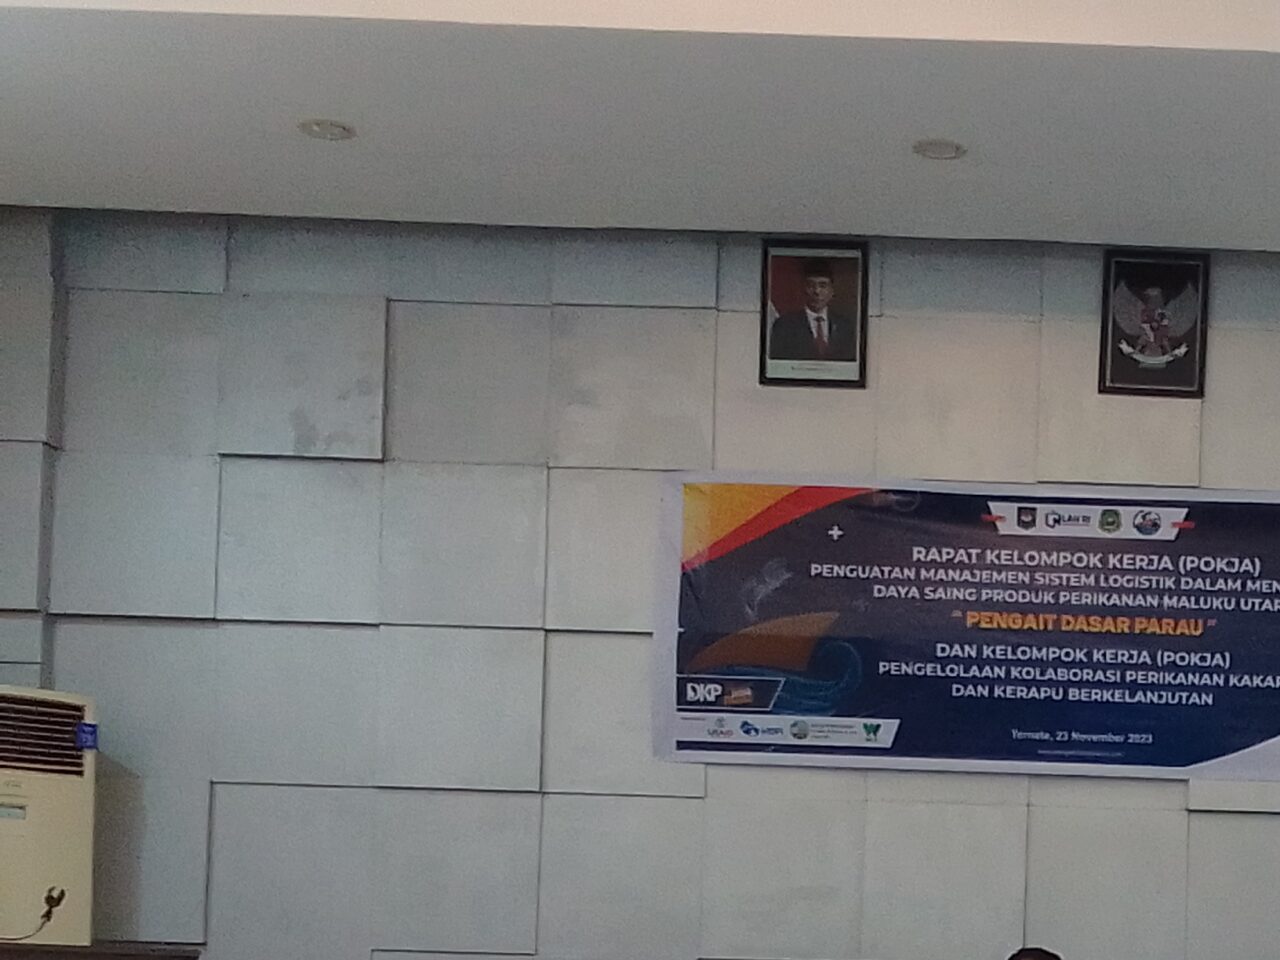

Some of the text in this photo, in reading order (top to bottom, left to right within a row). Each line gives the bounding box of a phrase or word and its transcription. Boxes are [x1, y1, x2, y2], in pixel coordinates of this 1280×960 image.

[912, 546, 1261, 577] RAPAT KELOMPOK KERJA (POKJA)
[810, 563, 916, 581] PENGUATAN
[919, 567, 1031, 586] MANAJEMEN
[1033, 571, 1096, 588] SISTEM
[1100, 573, 1176, 590] LOGISTIK
[1180, 576, 1243, 593] DALAM
[872, 584, 921, 600] DAYA
[924, 585, 977, 602] SAING
[981, 588, 1056, 605] PRODUK
[1059, 590, 1158, 608] PERIKANAN
[1165, 594, 1236, 611] MALUKU
[936, 642, 1231, 669] DAN KELOMPOK KERJA (POKJA)
[878, 661, 1006, 680] PENGELOLAAN
[1010, 666, 1121, 684] KOLABORASI
[1125, 670, 1225, 688] PERIKANAN
[951, 683, 1214, 706] DAN KERAPU BERKELANJUTAN
